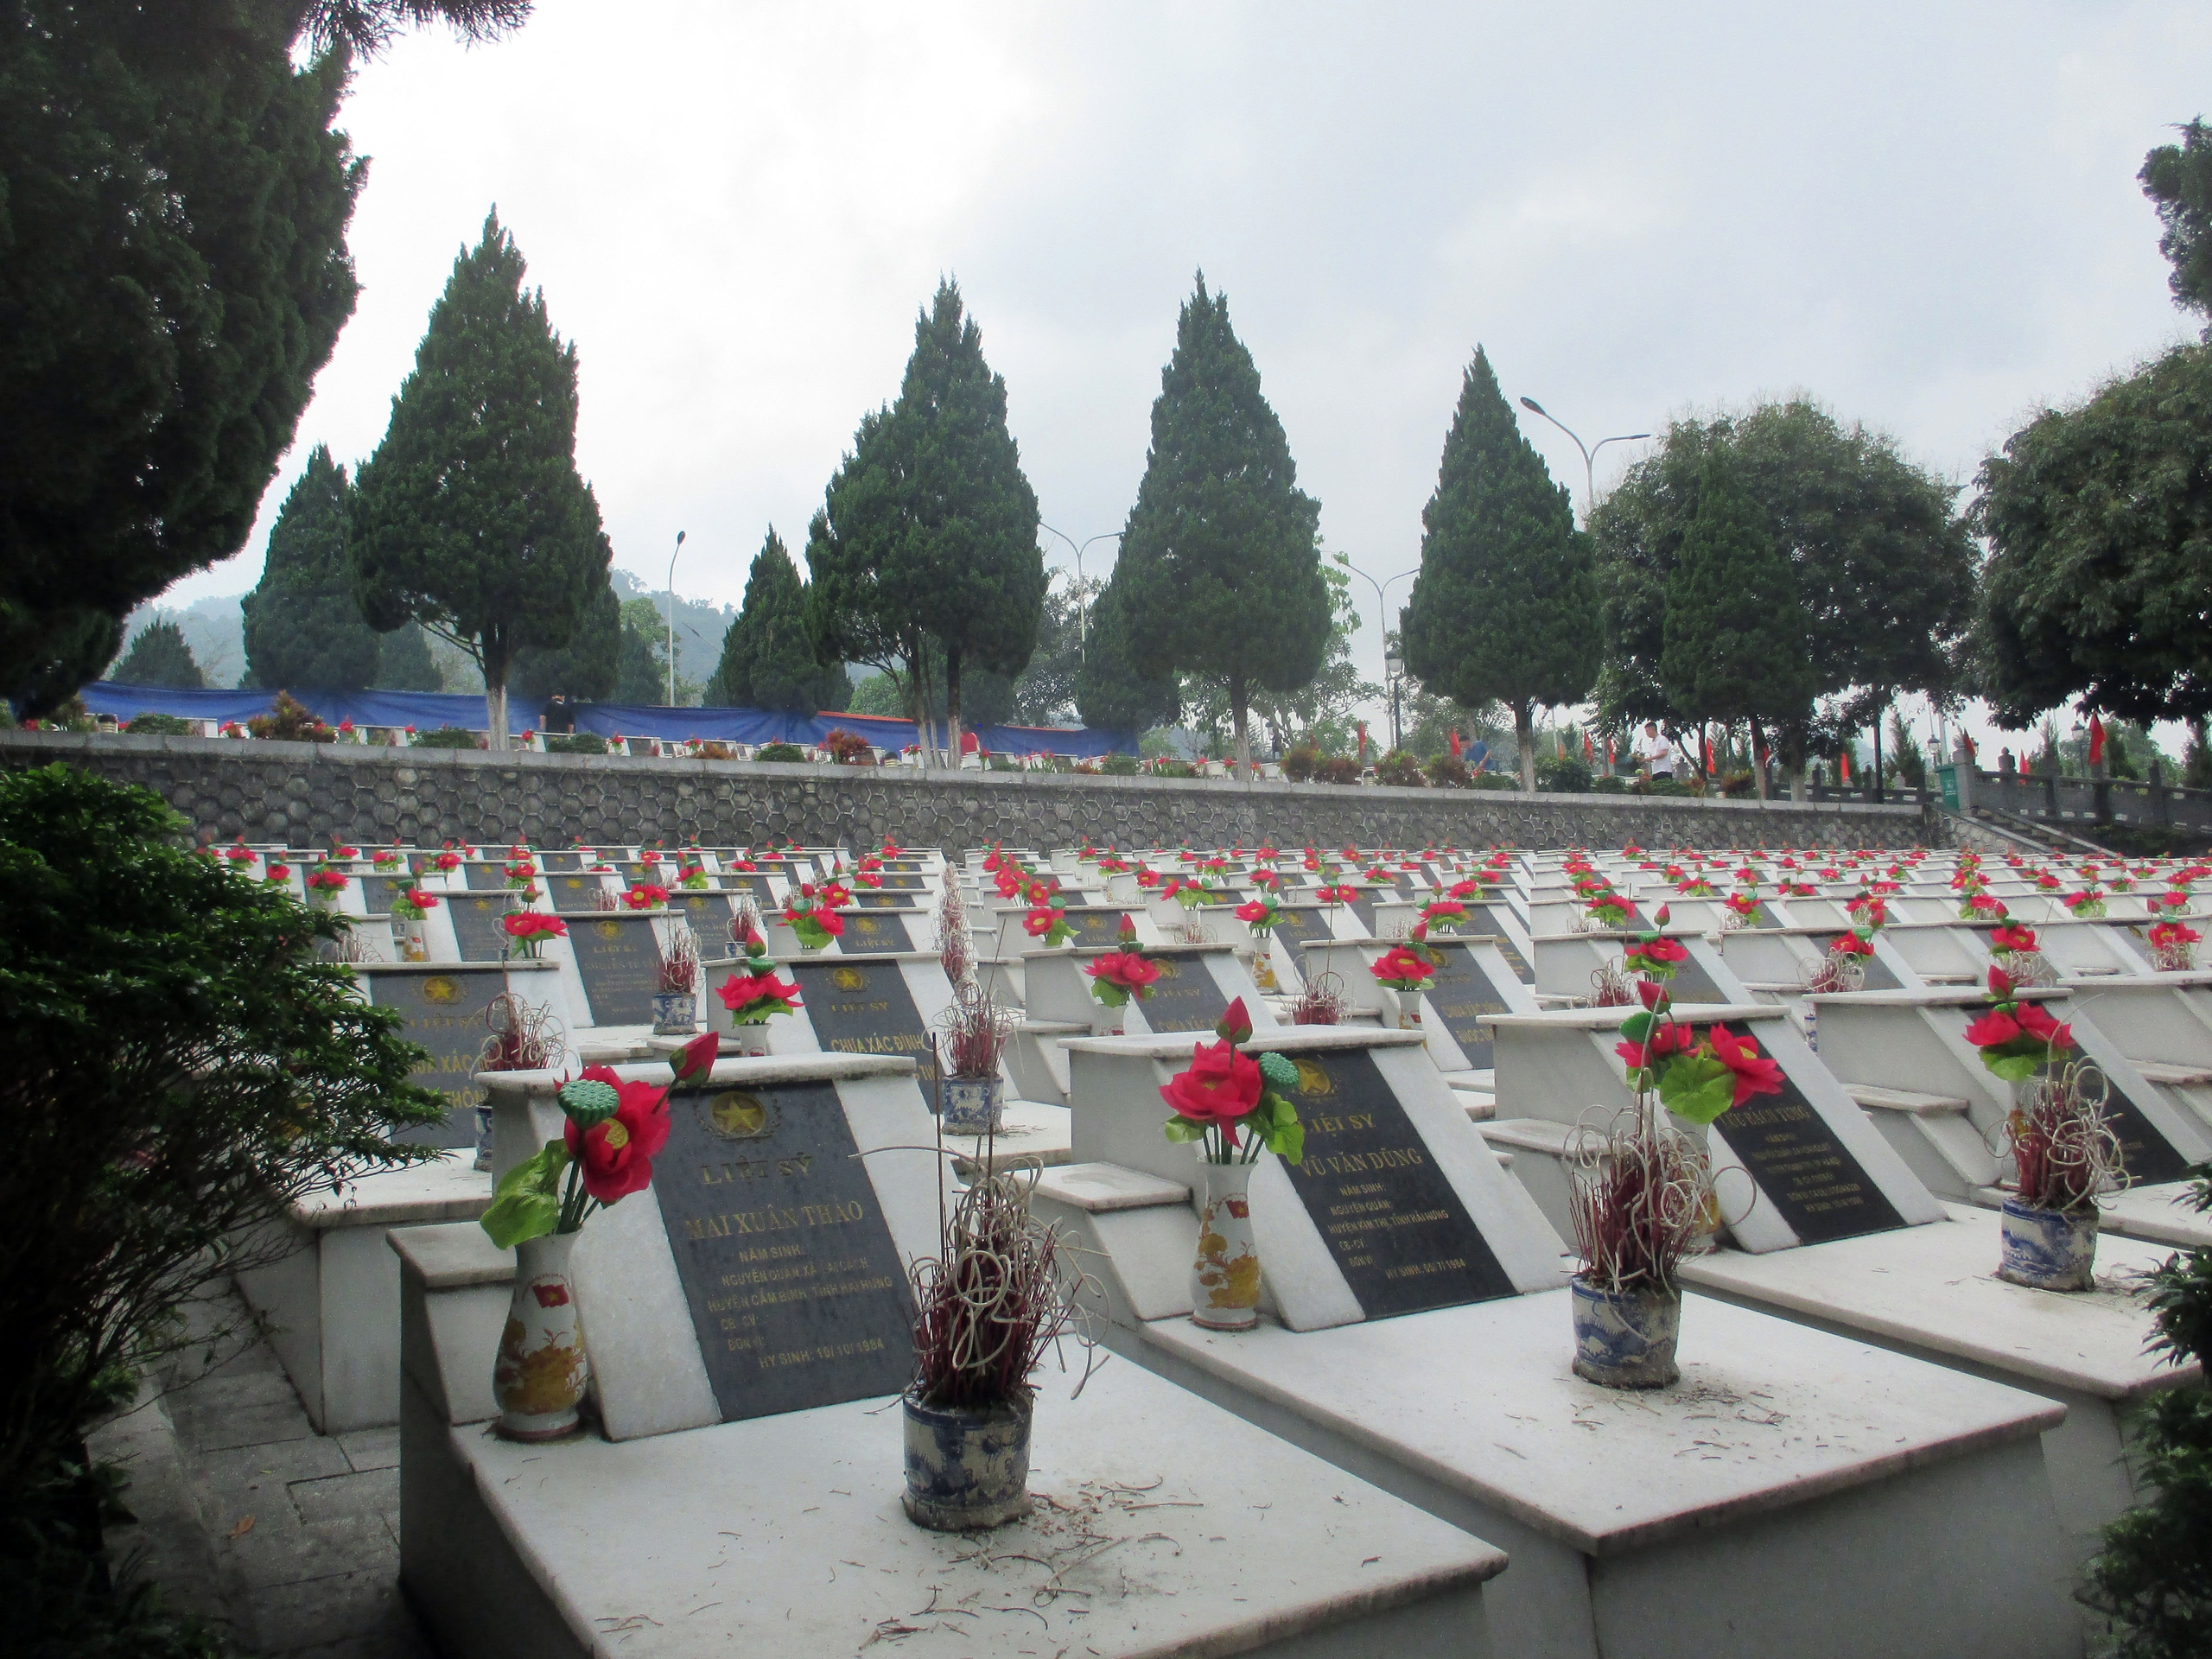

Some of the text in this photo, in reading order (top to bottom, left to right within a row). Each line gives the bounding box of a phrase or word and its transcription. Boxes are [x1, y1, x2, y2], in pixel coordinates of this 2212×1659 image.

[1325, 1151, 1369, 1173] VĂN
[1366, 1147, 1424, 1170] DŨNG
[684, 1214, 733, 1240] MAI
[732, 1203, 799, 1234] XUÂN
